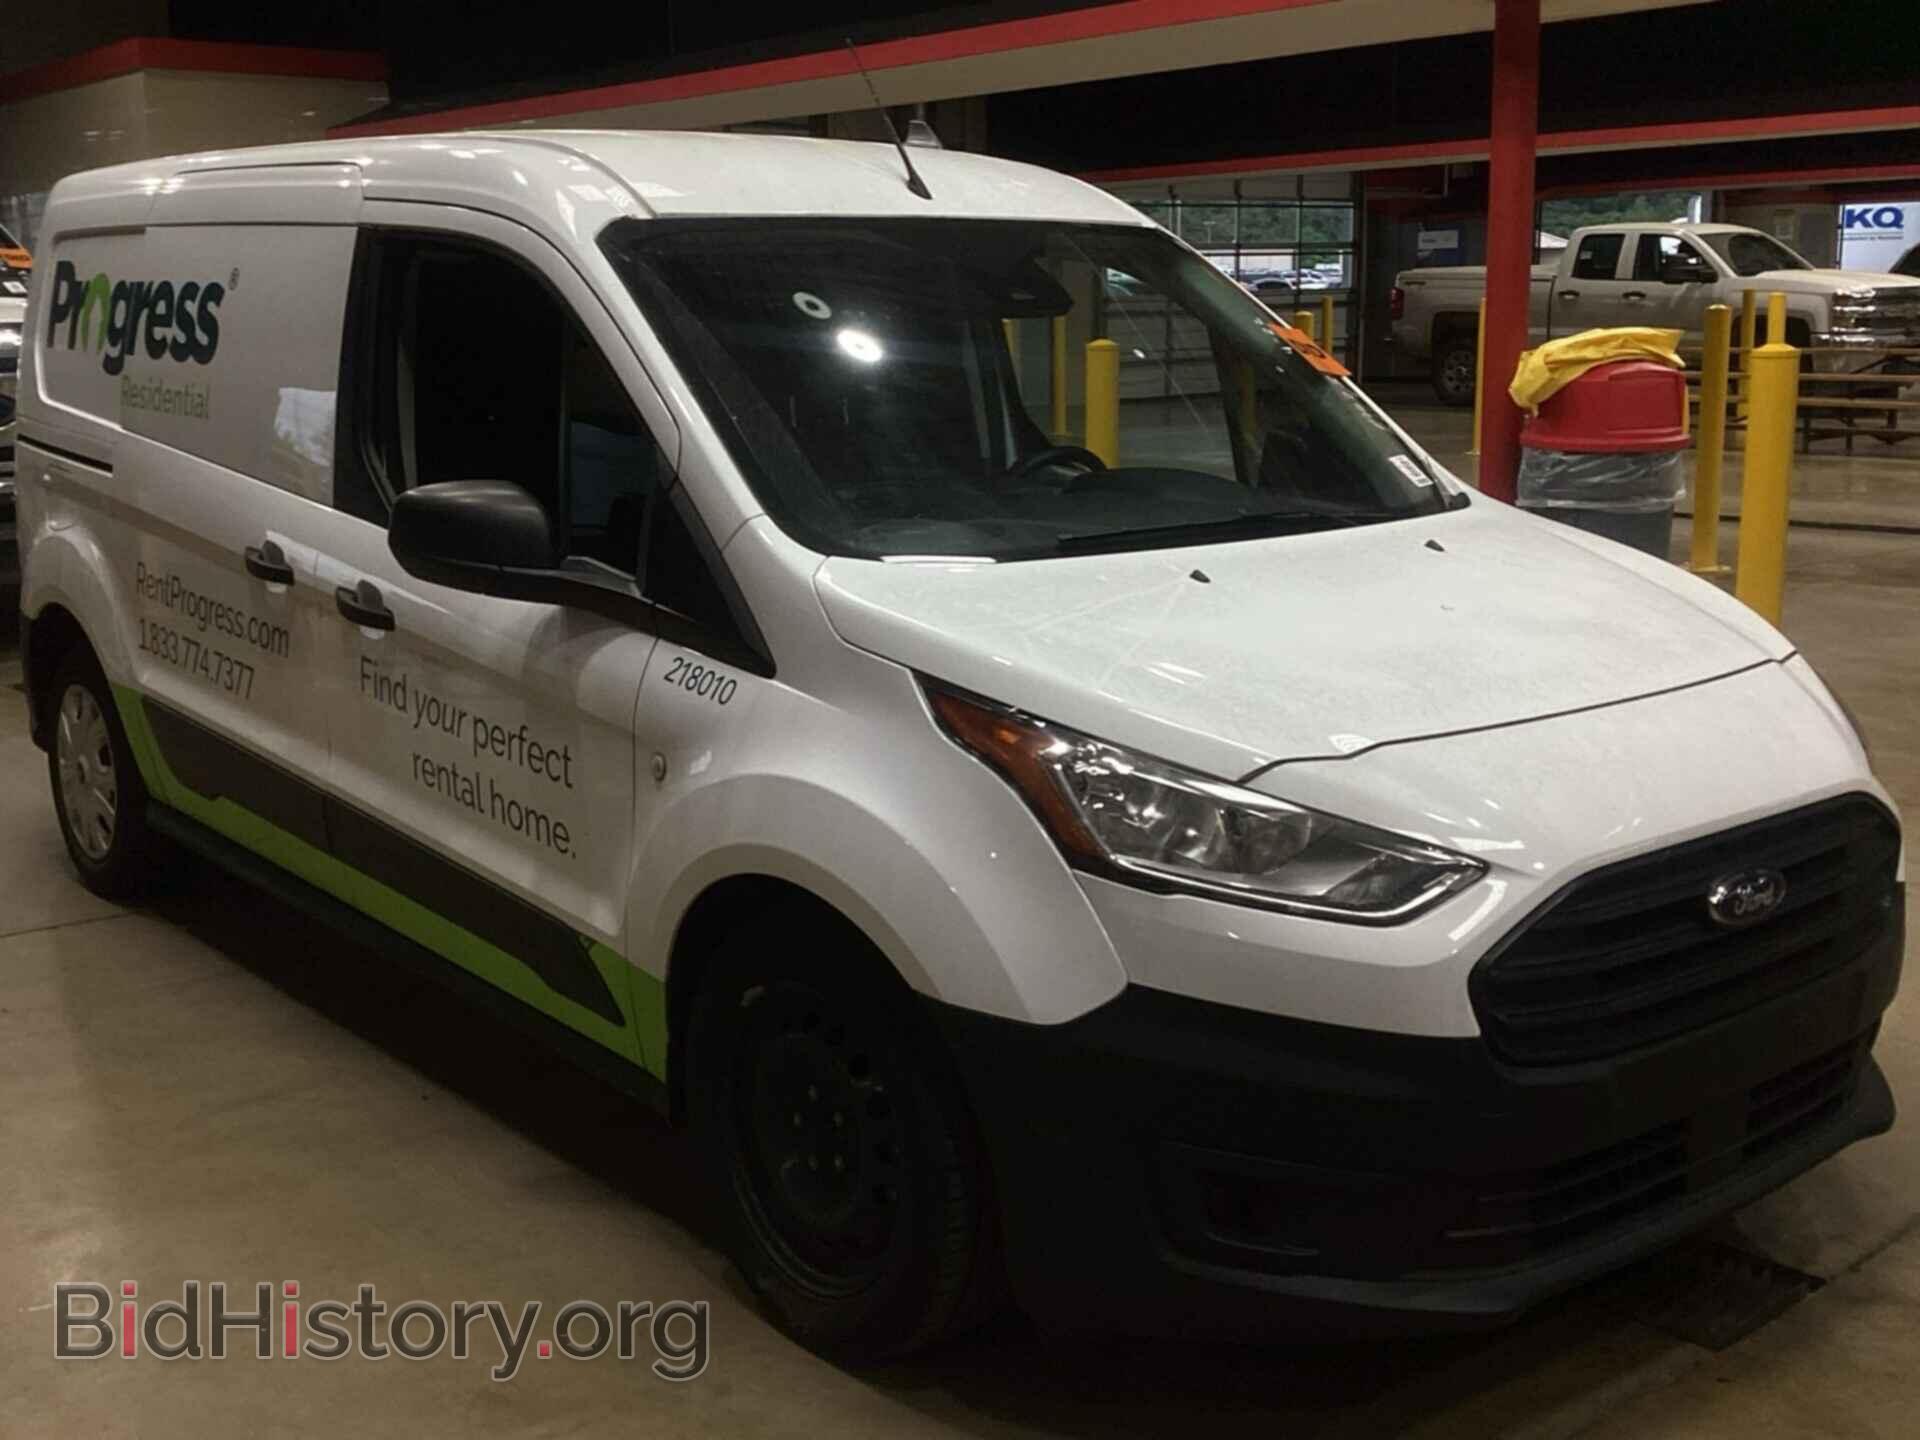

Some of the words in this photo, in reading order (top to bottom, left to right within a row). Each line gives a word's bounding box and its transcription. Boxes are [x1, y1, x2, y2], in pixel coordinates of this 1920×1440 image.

[120, 375, 210, 419] Residential
[136, 561, 290, 659] RentProgress.com
[360, 656, 408, 714] Find
[412, 689, 467, 740] your
[473, 716, 573, 789] perfect
[663, 656, 738, 706] 218010
[412, 751, 484, 815] rental
[490, 779, 577, 859] home.
